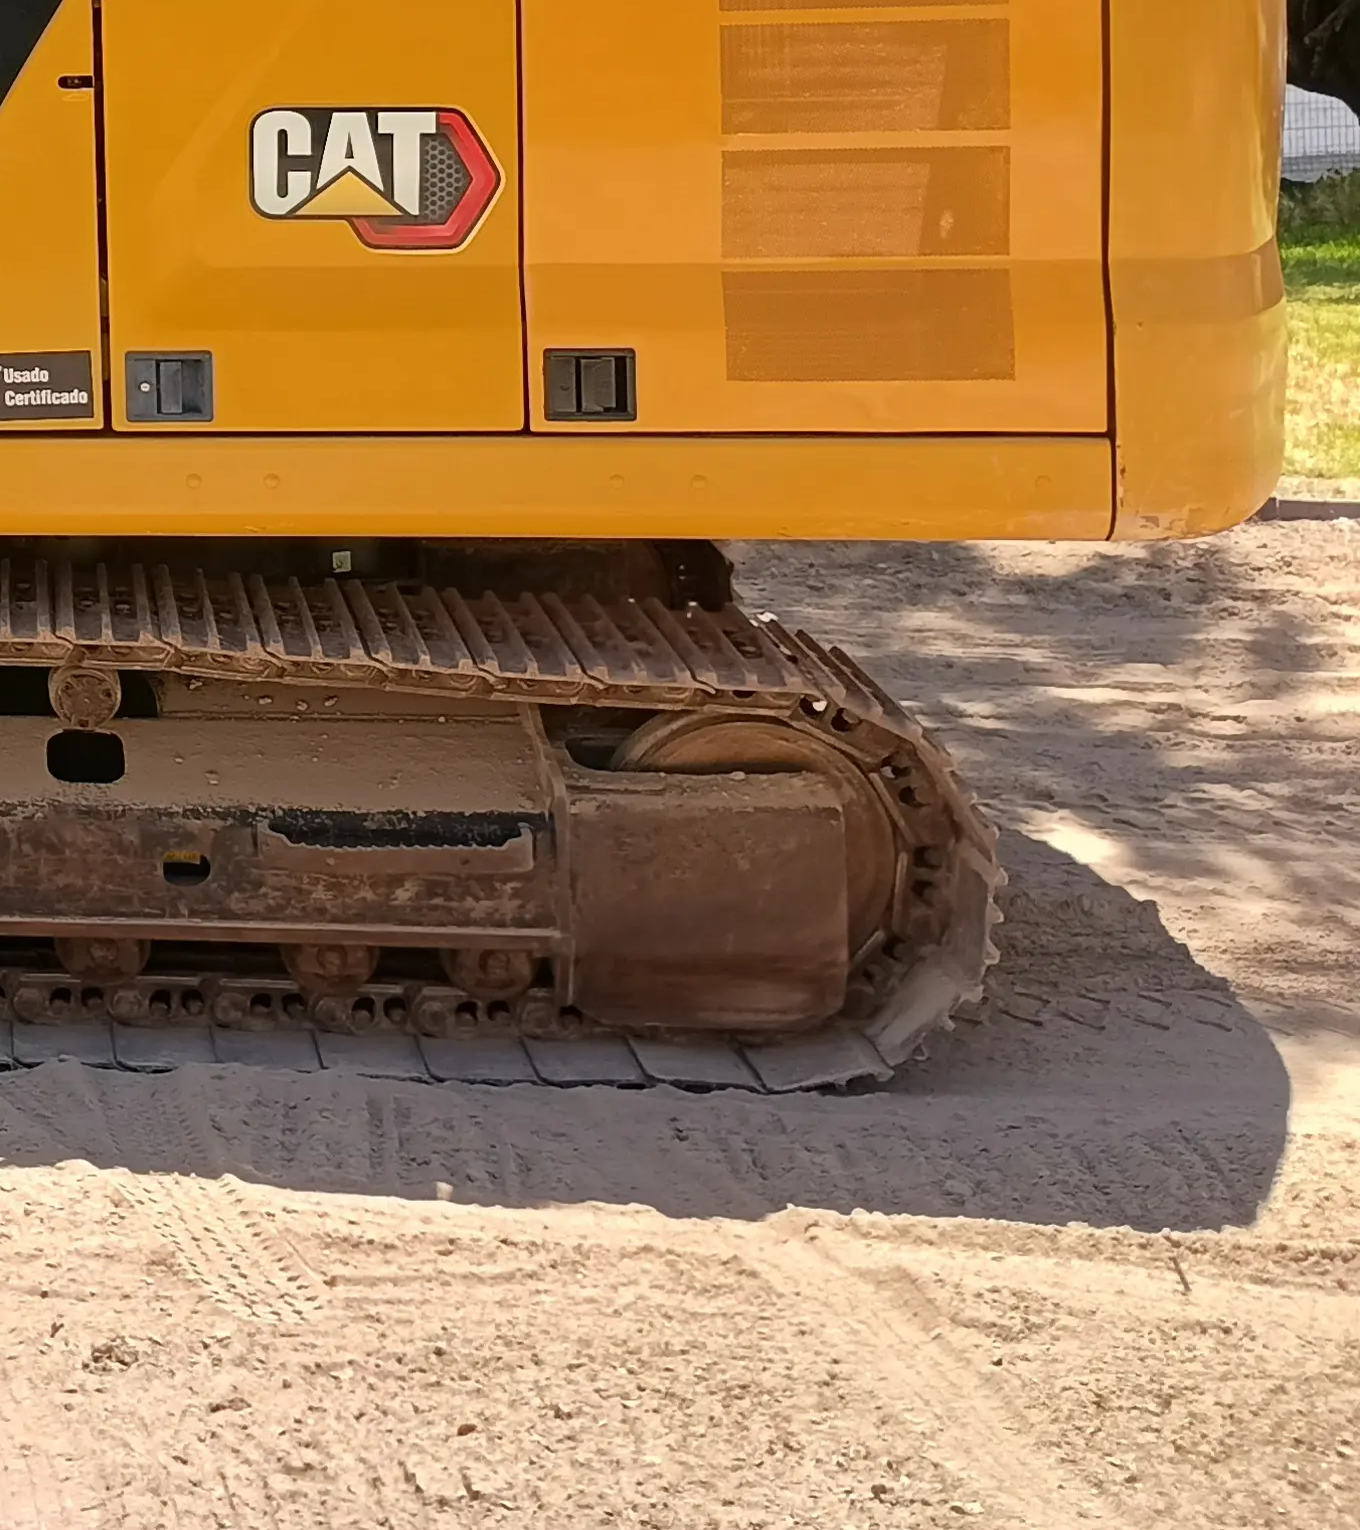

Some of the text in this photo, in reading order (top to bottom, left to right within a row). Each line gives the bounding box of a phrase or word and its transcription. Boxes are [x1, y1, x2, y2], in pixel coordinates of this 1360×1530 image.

[253, 110, 437, 216] CAT
[3, 367, 50, 384] Usado
[4, 388, 89, 407] Certificado
